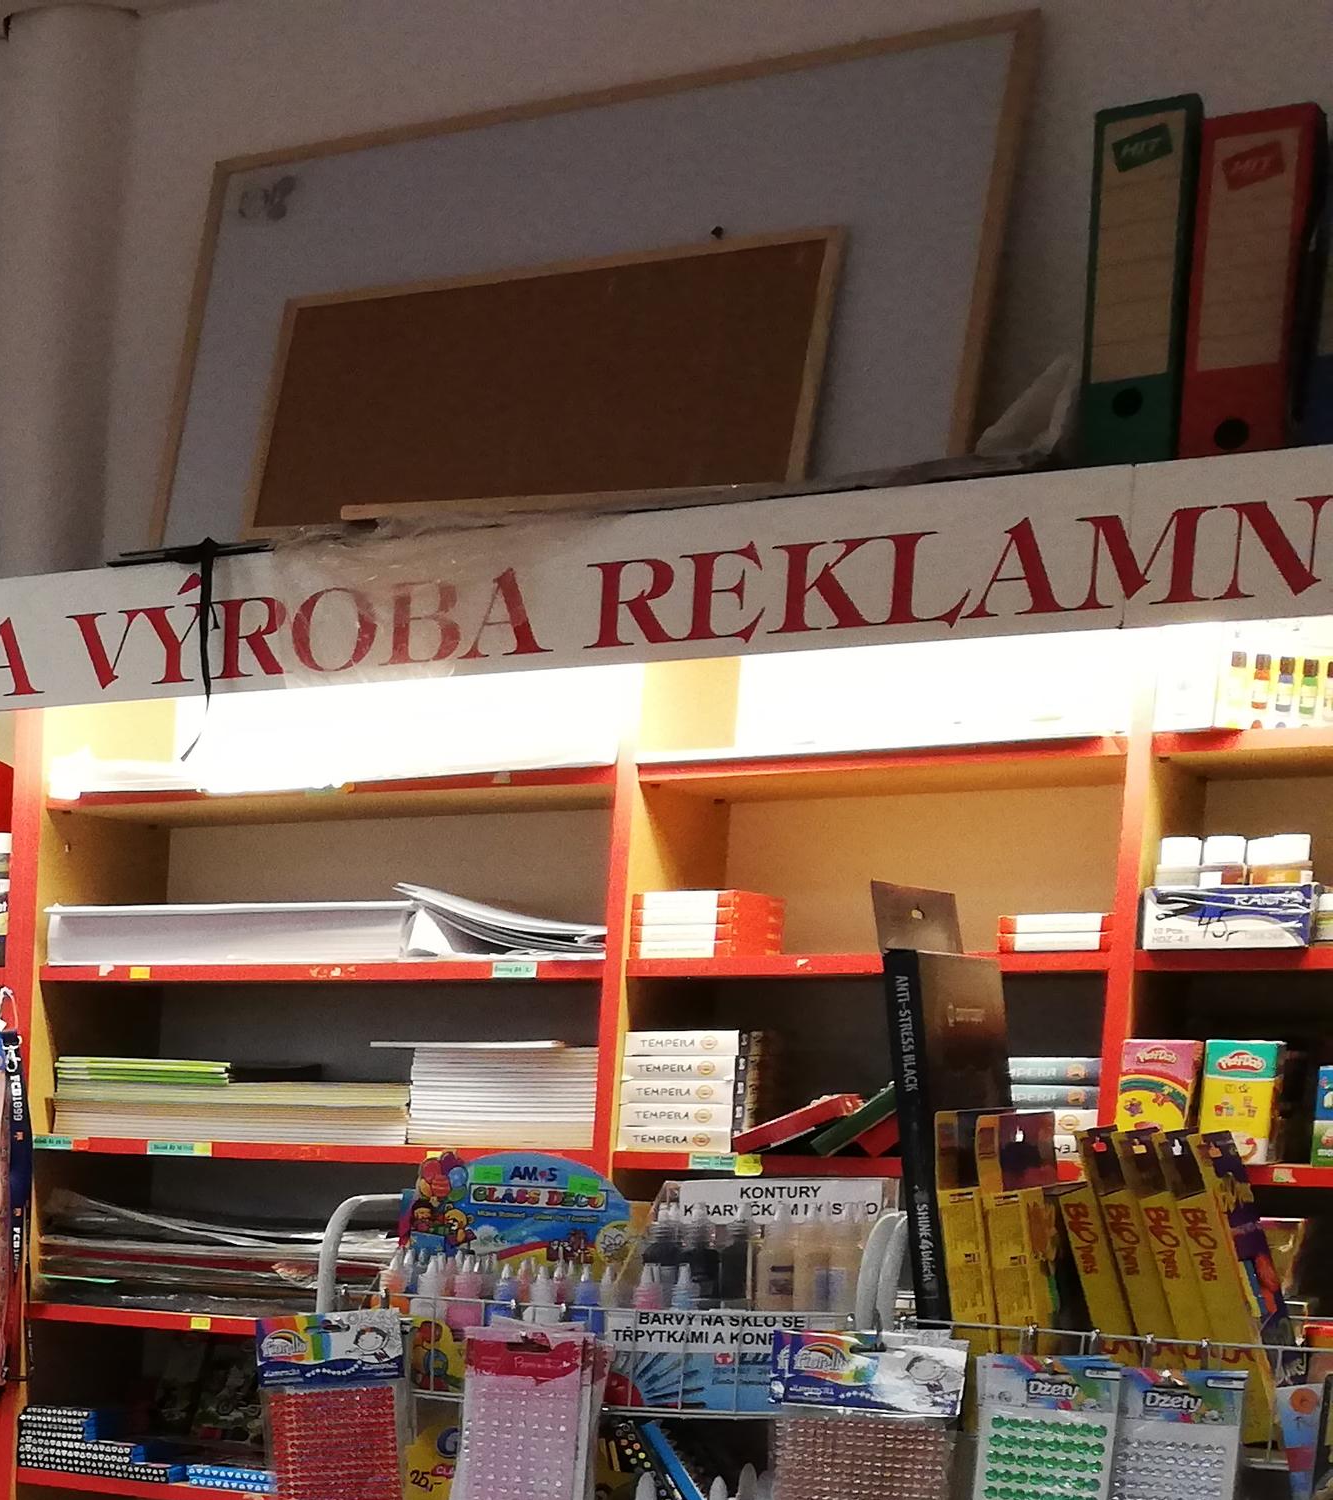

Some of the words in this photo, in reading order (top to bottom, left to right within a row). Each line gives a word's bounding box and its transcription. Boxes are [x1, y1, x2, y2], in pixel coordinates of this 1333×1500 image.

[1121, 135, 1164, 157] HIT
[69, 573, 554, 689] VÝROBA
[640, 1038, 695, 1049] TEMPERA
[637, 1063, 693, 1073] TEMPERA
[635, 1086, 691, 1098] TEMPERA
[634, 1109, 689, 1121] TEMPERA
[632, 1134, 688, 1146] TEMPERA
[472, 1185, 541, 1206] GLASS
[545, 1188, 605, 1209] DECO
[739, 1184, 822, 1201] KONTURY
[639, 1312, 695, 1327] BARVY
[729, 1313, 779, 1327] SKLO
[783, 1314, 805, 1328] SE
[613, 1326, 710, 1345] TŘPYTKAMI
[713, 1331, 726, 1345] A
